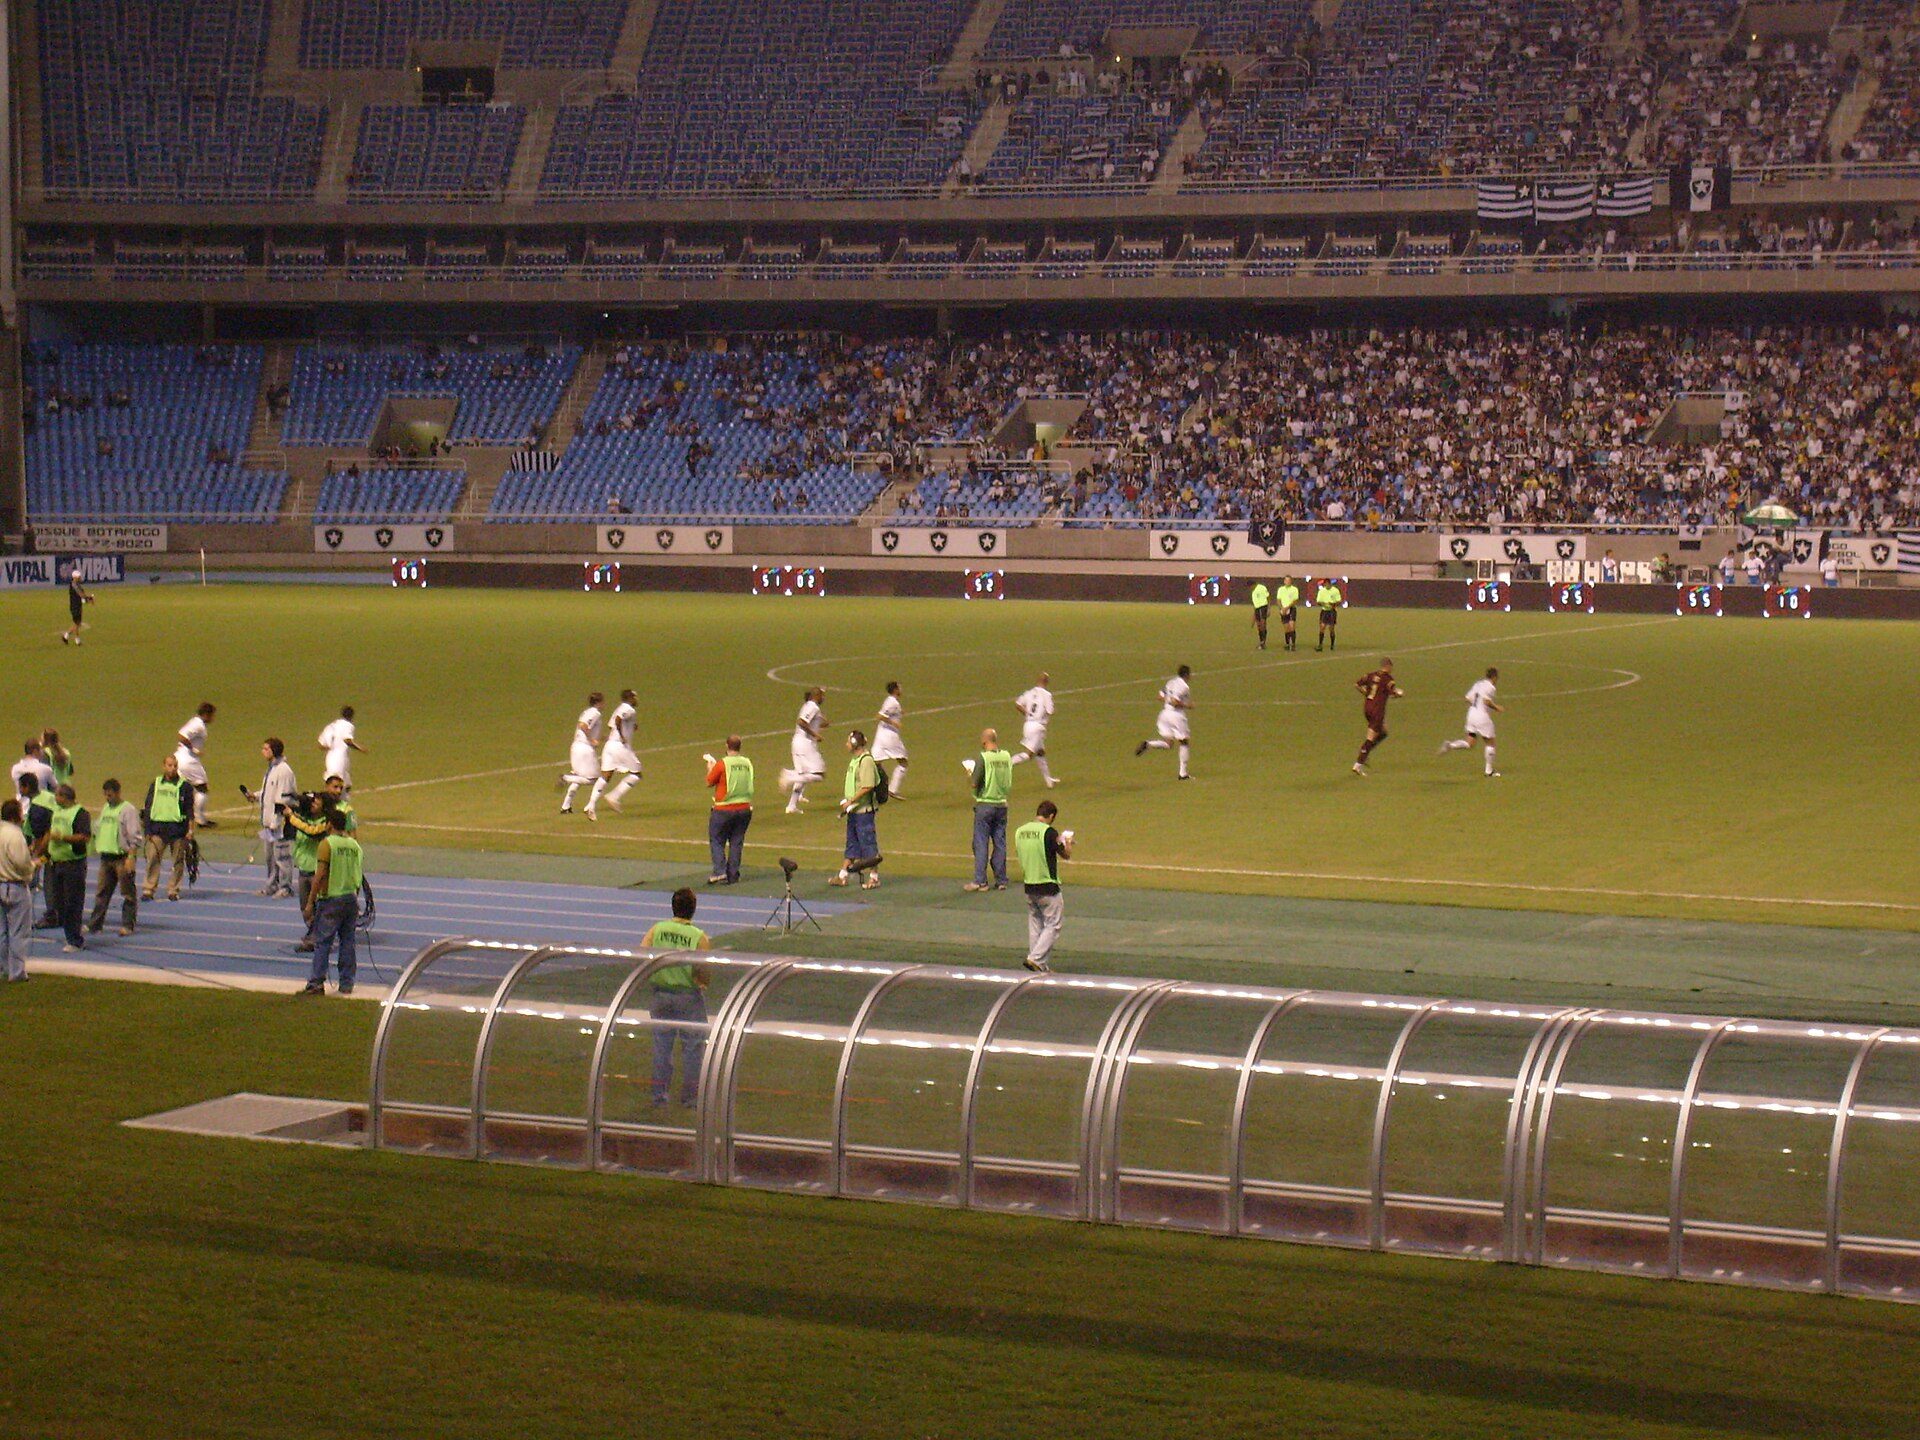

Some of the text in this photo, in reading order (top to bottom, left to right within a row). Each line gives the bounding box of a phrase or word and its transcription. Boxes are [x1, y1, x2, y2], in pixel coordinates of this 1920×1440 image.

[87, 527, 161, 537] BOTAFOGO
[5, 560, 50, 585] VIPAL
[75, 557, 121, 582] VIPAL
[660, 931, 692, 948] IMPRENSA
